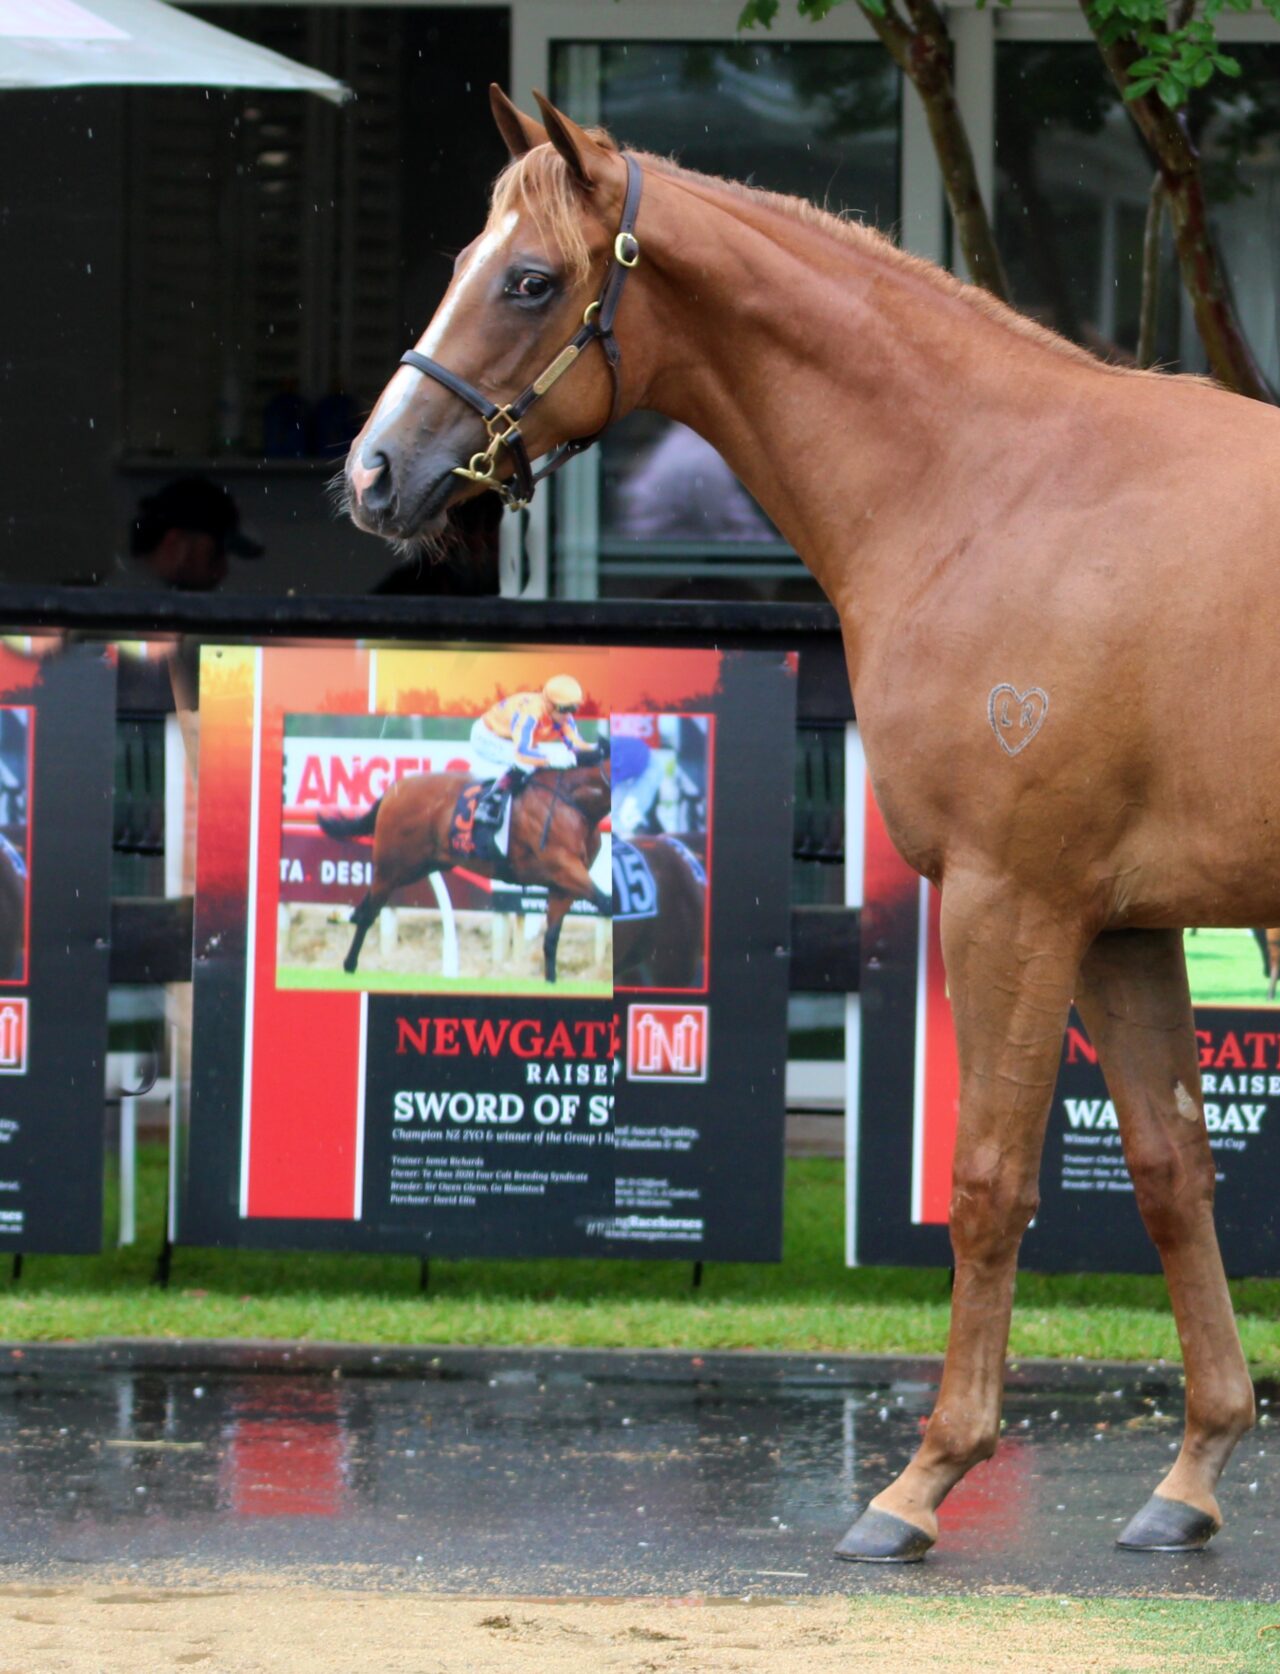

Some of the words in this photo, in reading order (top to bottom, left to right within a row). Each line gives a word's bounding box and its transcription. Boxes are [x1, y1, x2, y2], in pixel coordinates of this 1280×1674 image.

[321, 860, 372, 885] DESI
[393, 1091, 525, 1123] SWORD
[533, 1094, 580, 1125] OF
[588, 1095, 615, 1126] S
[1203, 1103, 1266, 1132] BAY
[392, 1128, 443, 1144] Champion
[445, 1129, 460, 1142] NZ
[462, 1130, 484, 1143] 2YO
[496, 1131, 532, 1143] winner
[534, 1131, 545, 1146] of
[546, 1131, 562, 1144] the
[564, 1132, 595, 1147] Group
[1063, 1133, 1101, 1145] Winner
[1224, 1138, 1247, 1151] Cup
[392, 1156, 424, 1167] Trainer:
[450, 1157, 484, 1168] Richards
